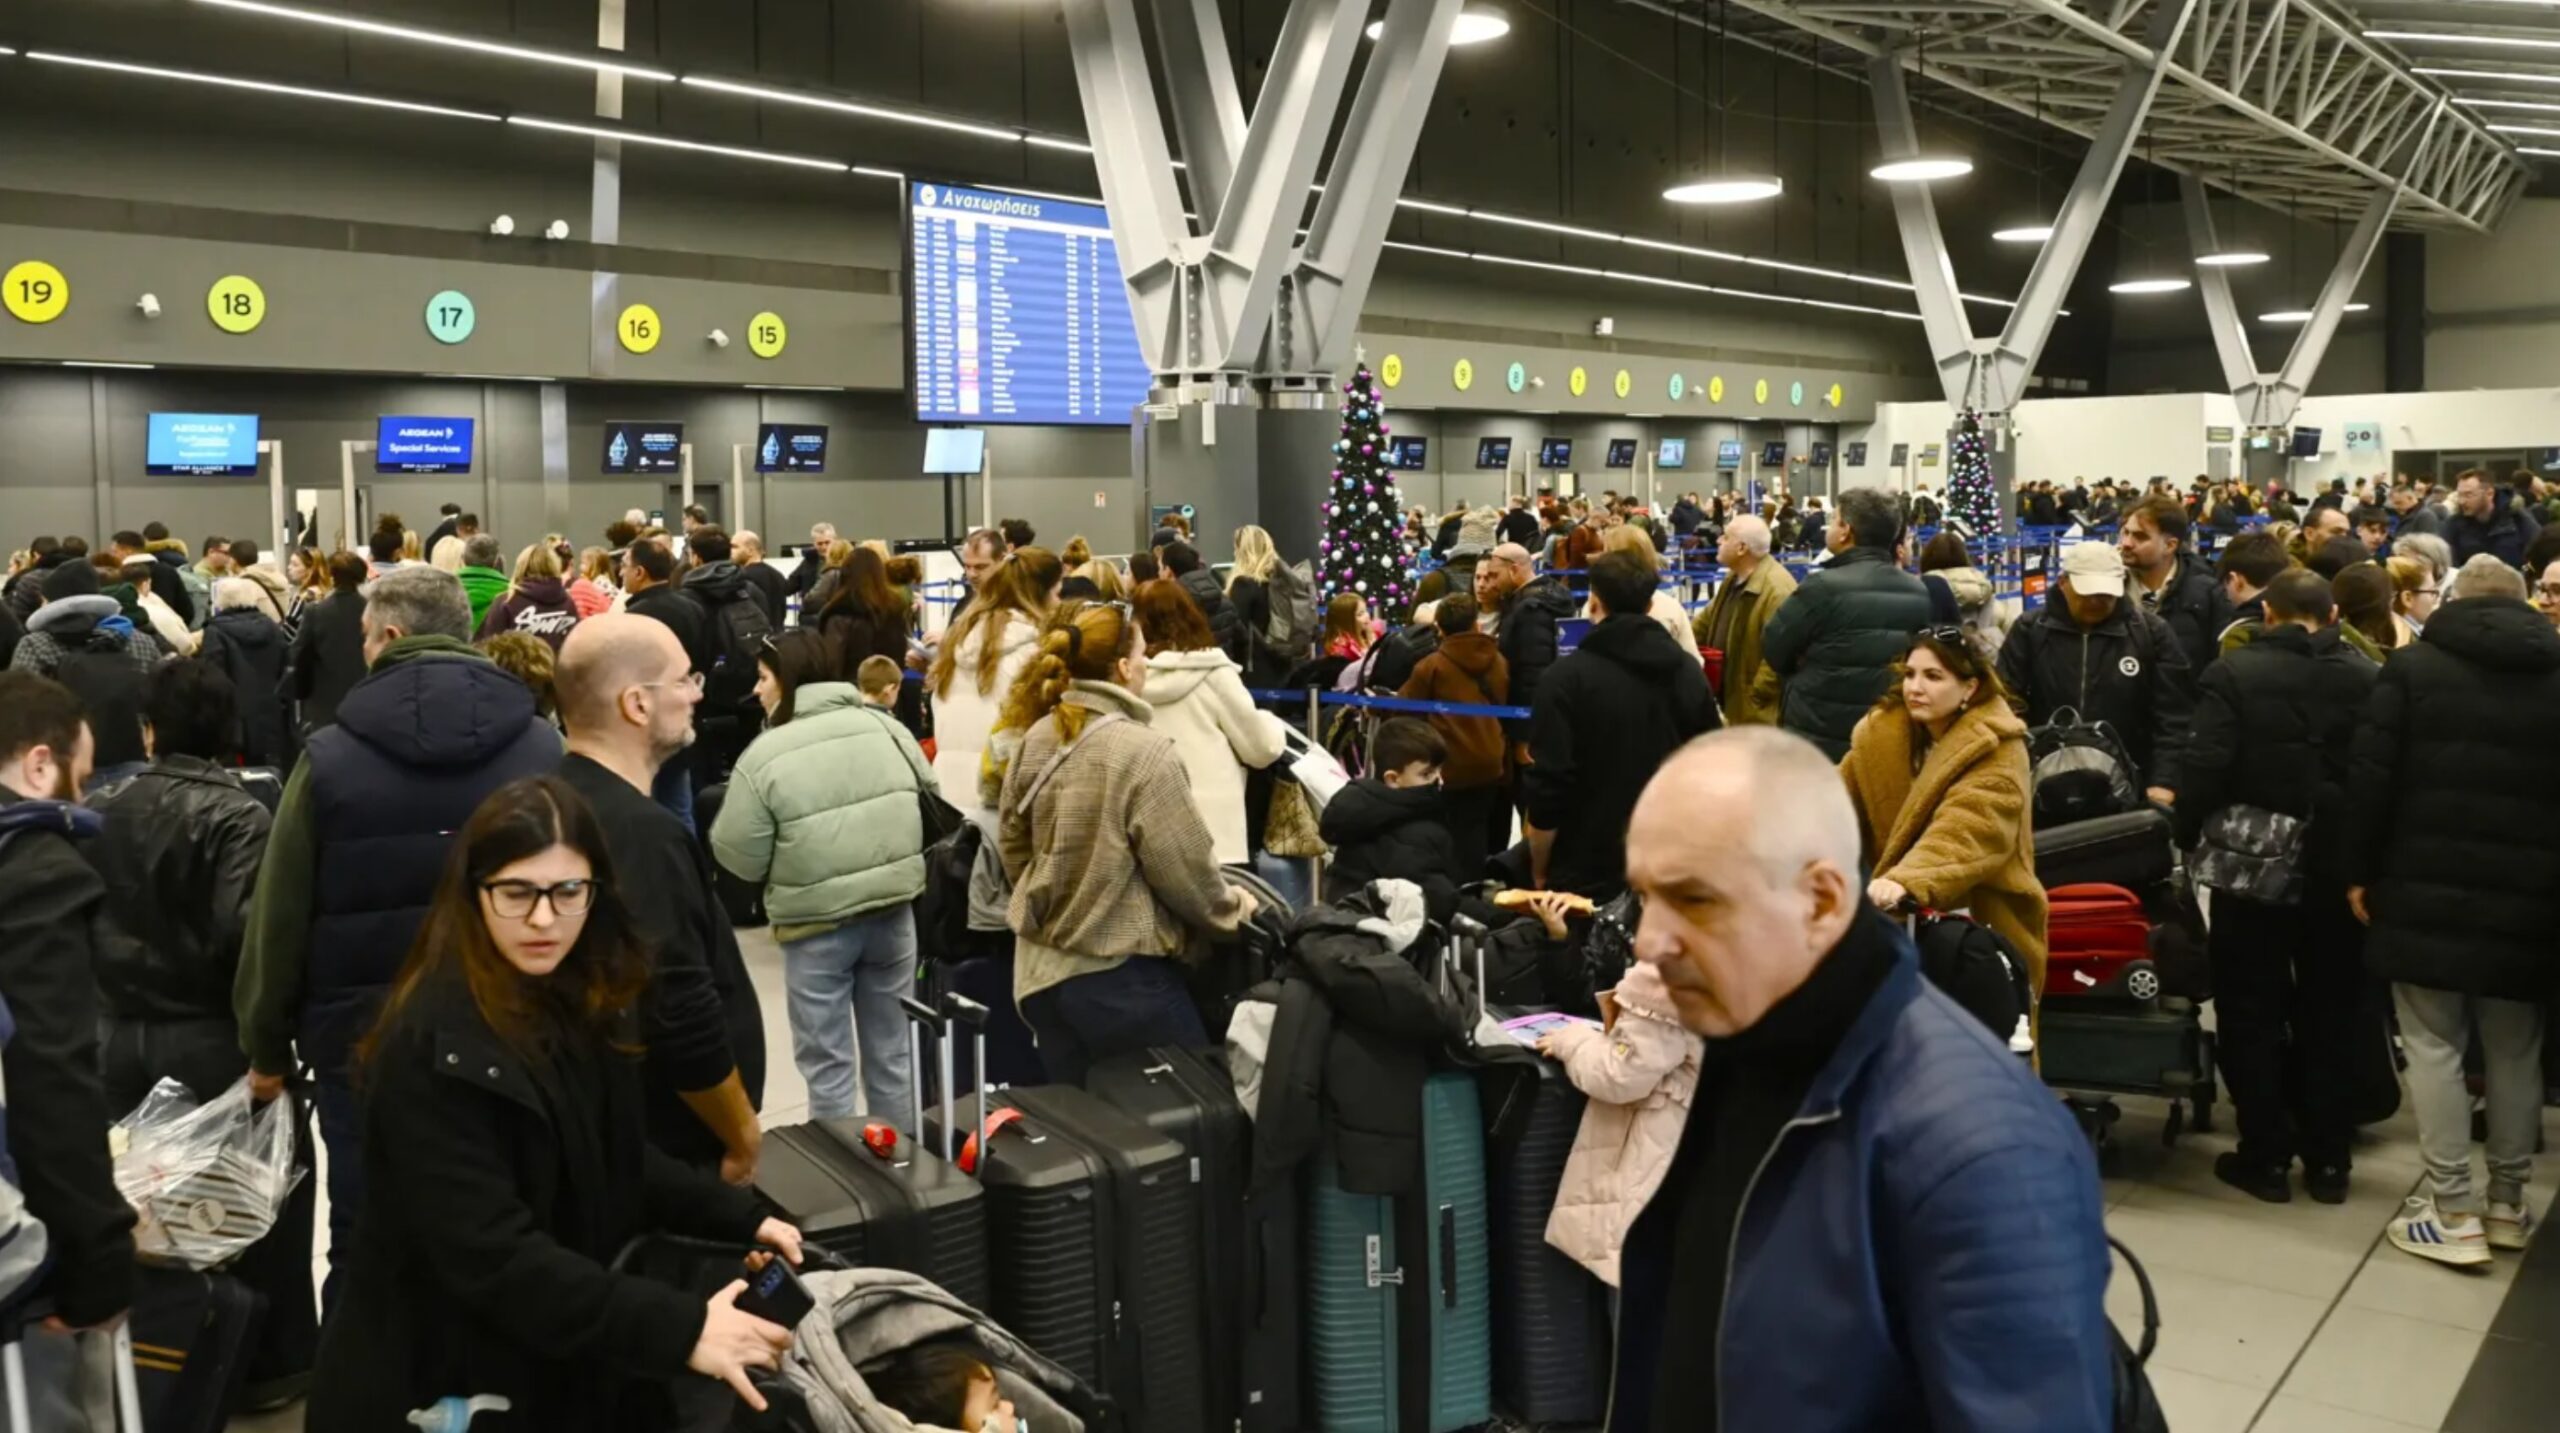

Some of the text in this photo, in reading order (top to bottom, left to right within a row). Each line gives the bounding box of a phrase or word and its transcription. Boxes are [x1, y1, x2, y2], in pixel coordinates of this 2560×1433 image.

[942, 189, 1040, 217] Αναχωρήσεις
[19, 280, 53, 304] 19
[222, 292, 251, 316] 18
[439, 307, 463, 328] 17
[629, 319, 650, 339] 16
[758, 325, 777, 344] 15
[1387, 363, 1397, 378] 10
[1459, 367, 1467, 381] 9
[1513, 371, 1520, 384] 8
[172, 424, 225, 433] AEGEAN
[398, 428, 444, 437] AEGEAN
[389, 442, 461, 454] Special Services
